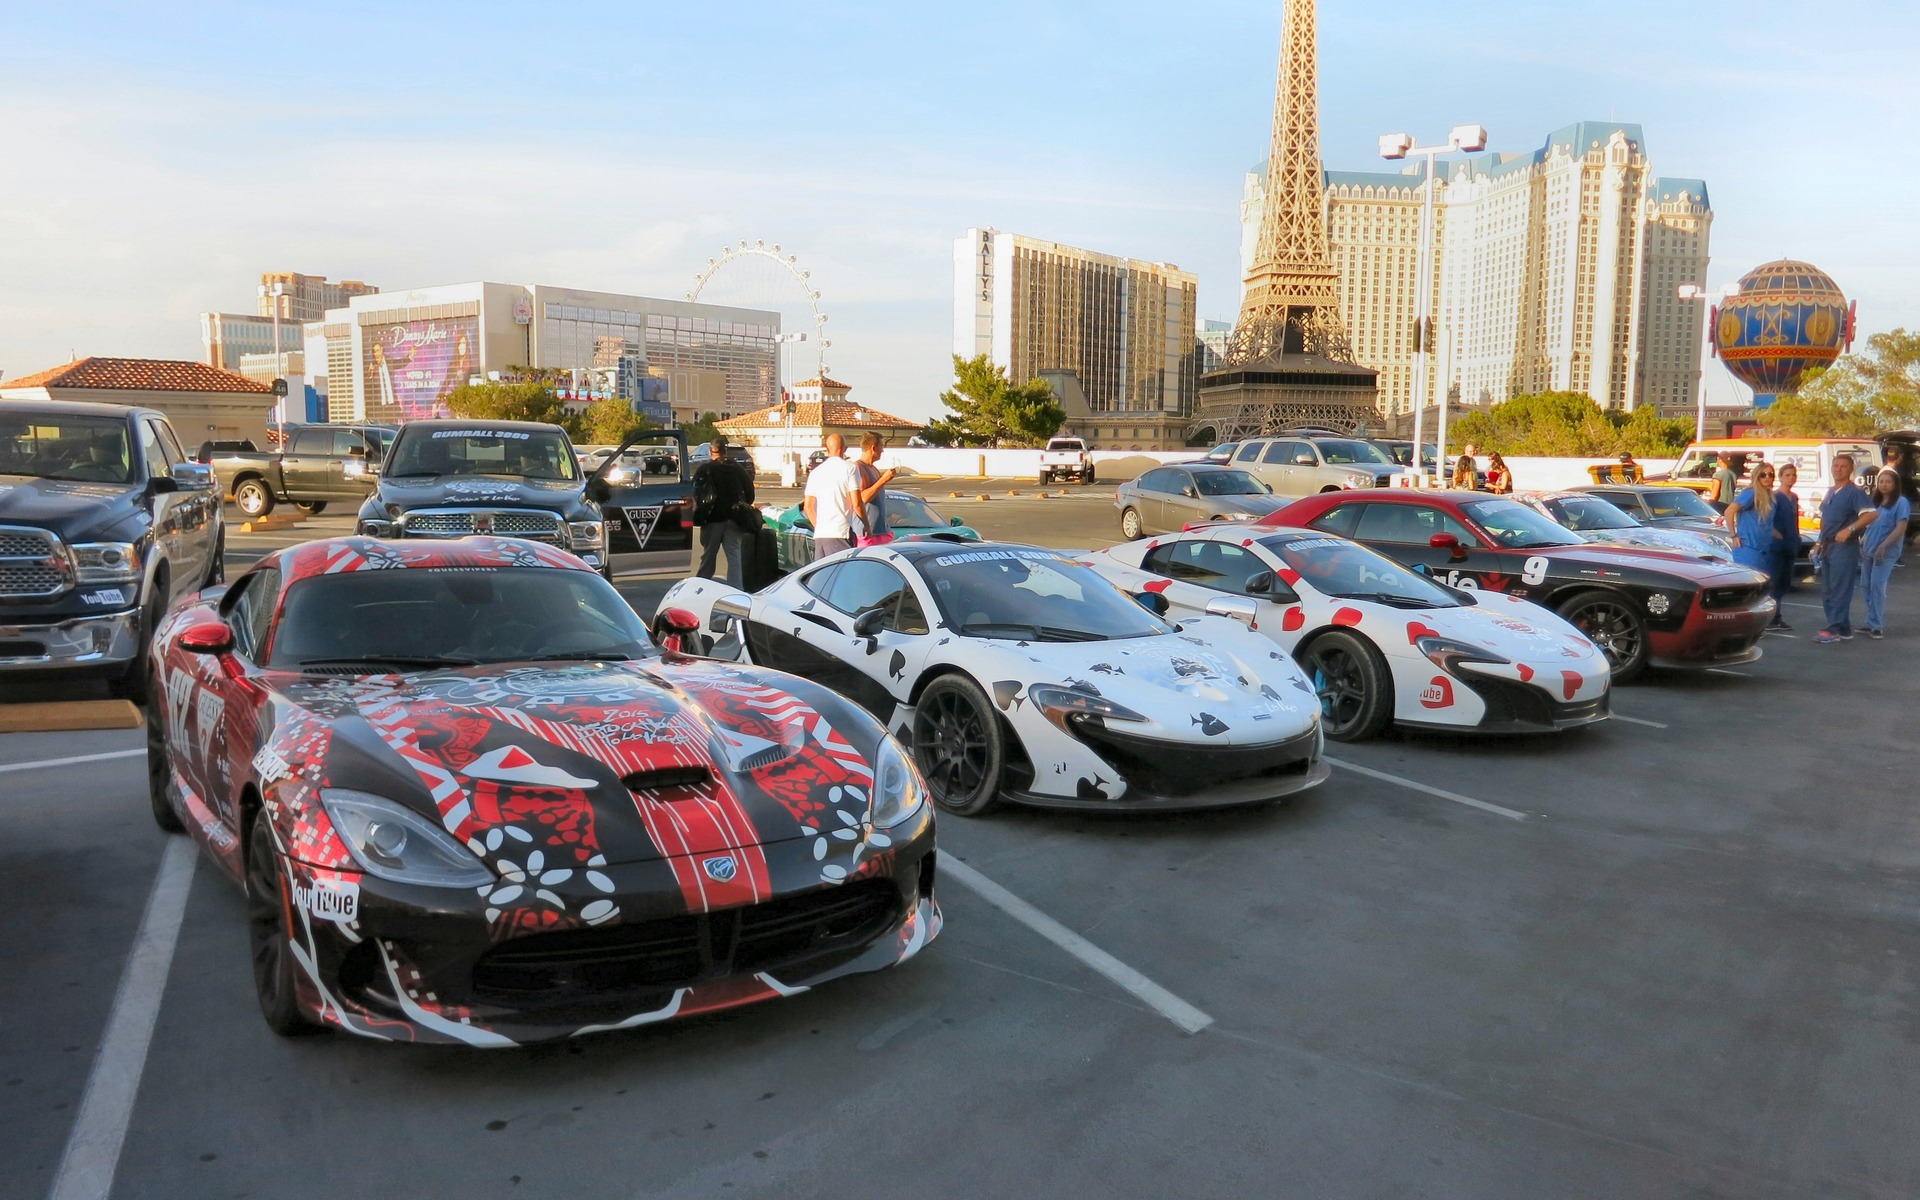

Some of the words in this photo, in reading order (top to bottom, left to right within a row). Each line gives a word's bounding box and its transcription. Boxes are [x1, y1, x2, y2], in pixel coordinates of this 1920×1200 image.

[981, 231, 990, 301] BALLYS
[1673, 410, 1732, 418] MONUENTAL
[432, 430, 493, 439] GUMBALL
[495, 431, 530, 440] 3000
[629, 510, 656, 520] GUESS
[936, 551, 1019, 567] GUMBALL
[1521, 556, 1549, 586] 9
[80, 588, 125, 605] YouTube
[199, 692, 224, 723] GUESS
